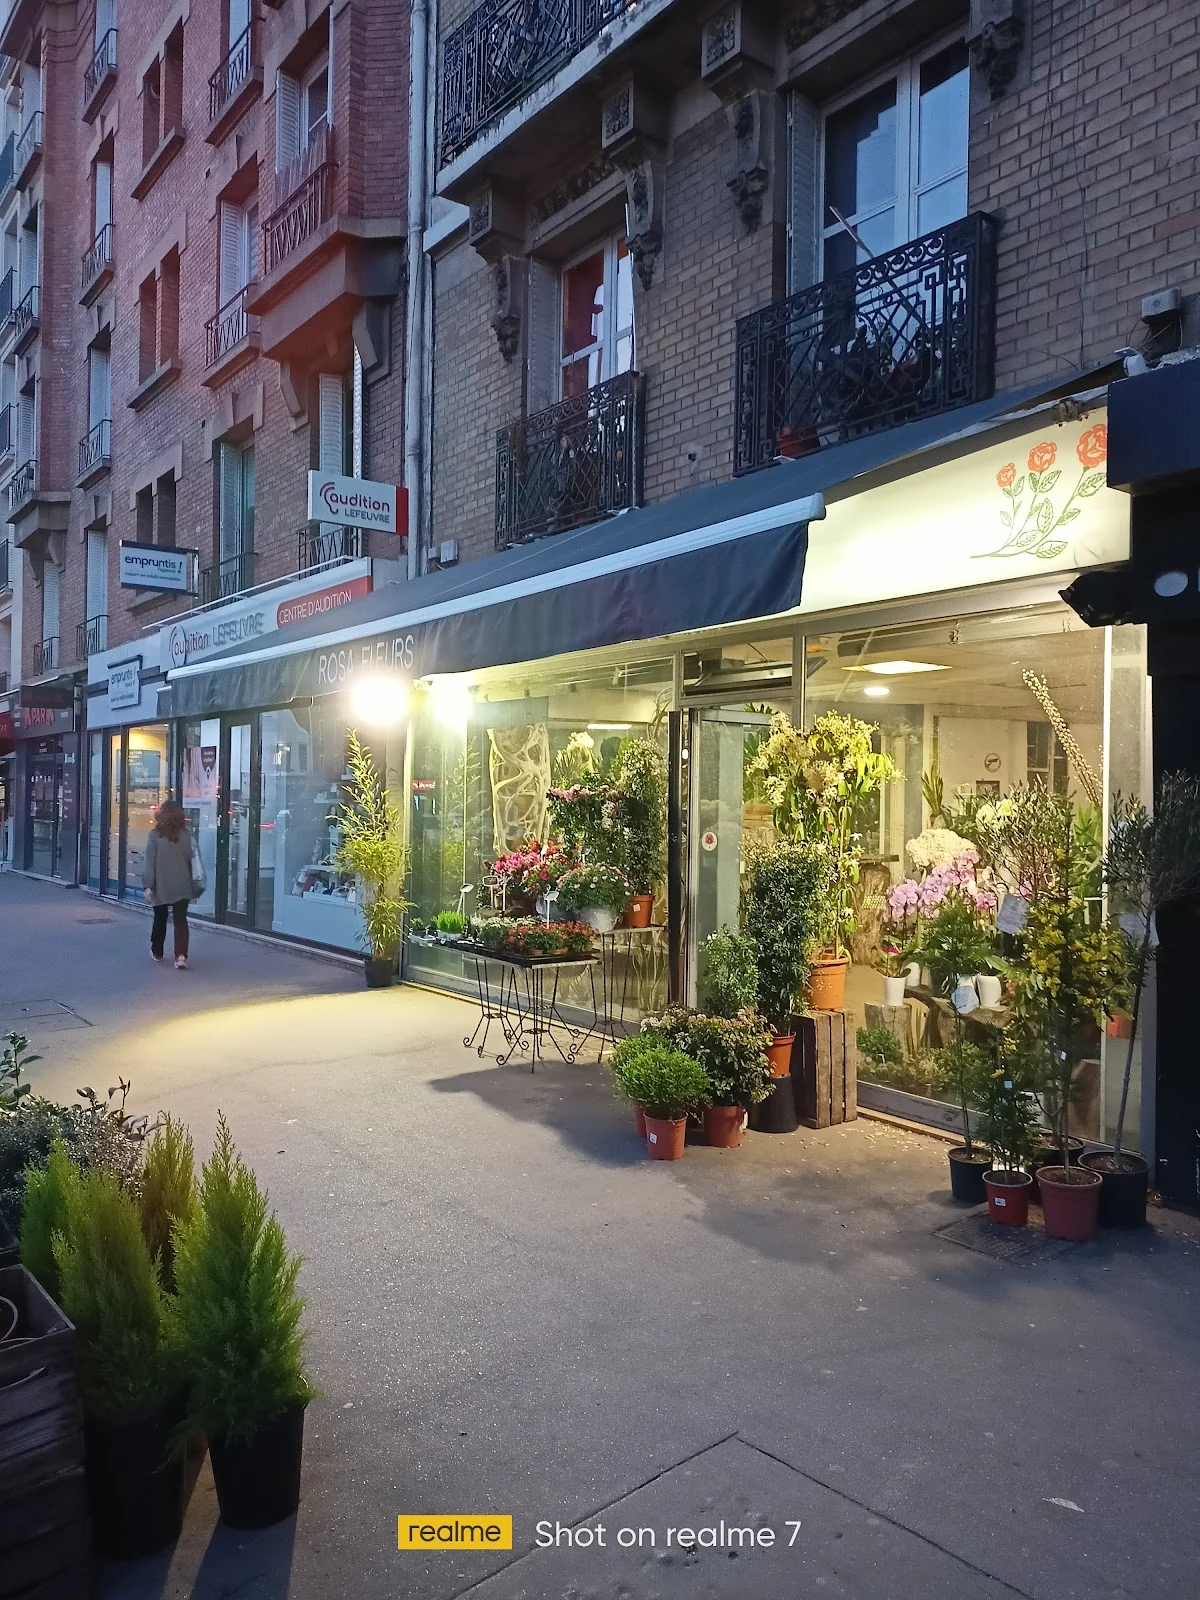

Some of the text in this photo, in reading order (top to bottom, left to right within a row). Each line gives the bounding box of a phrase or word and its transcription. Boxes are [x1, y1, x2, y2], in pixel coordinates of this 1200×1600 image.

[330, 493, 390, 513] audition
[344, 507, 390, 524] LEFEUVRE
[124, 555, 176, 569] empruntis
[279, 589, 352, 624] CENTRE D'AUDITION
[212, 612, 264, 646] LEFEUVRE
[319, 649, 354, 684] ROSA
